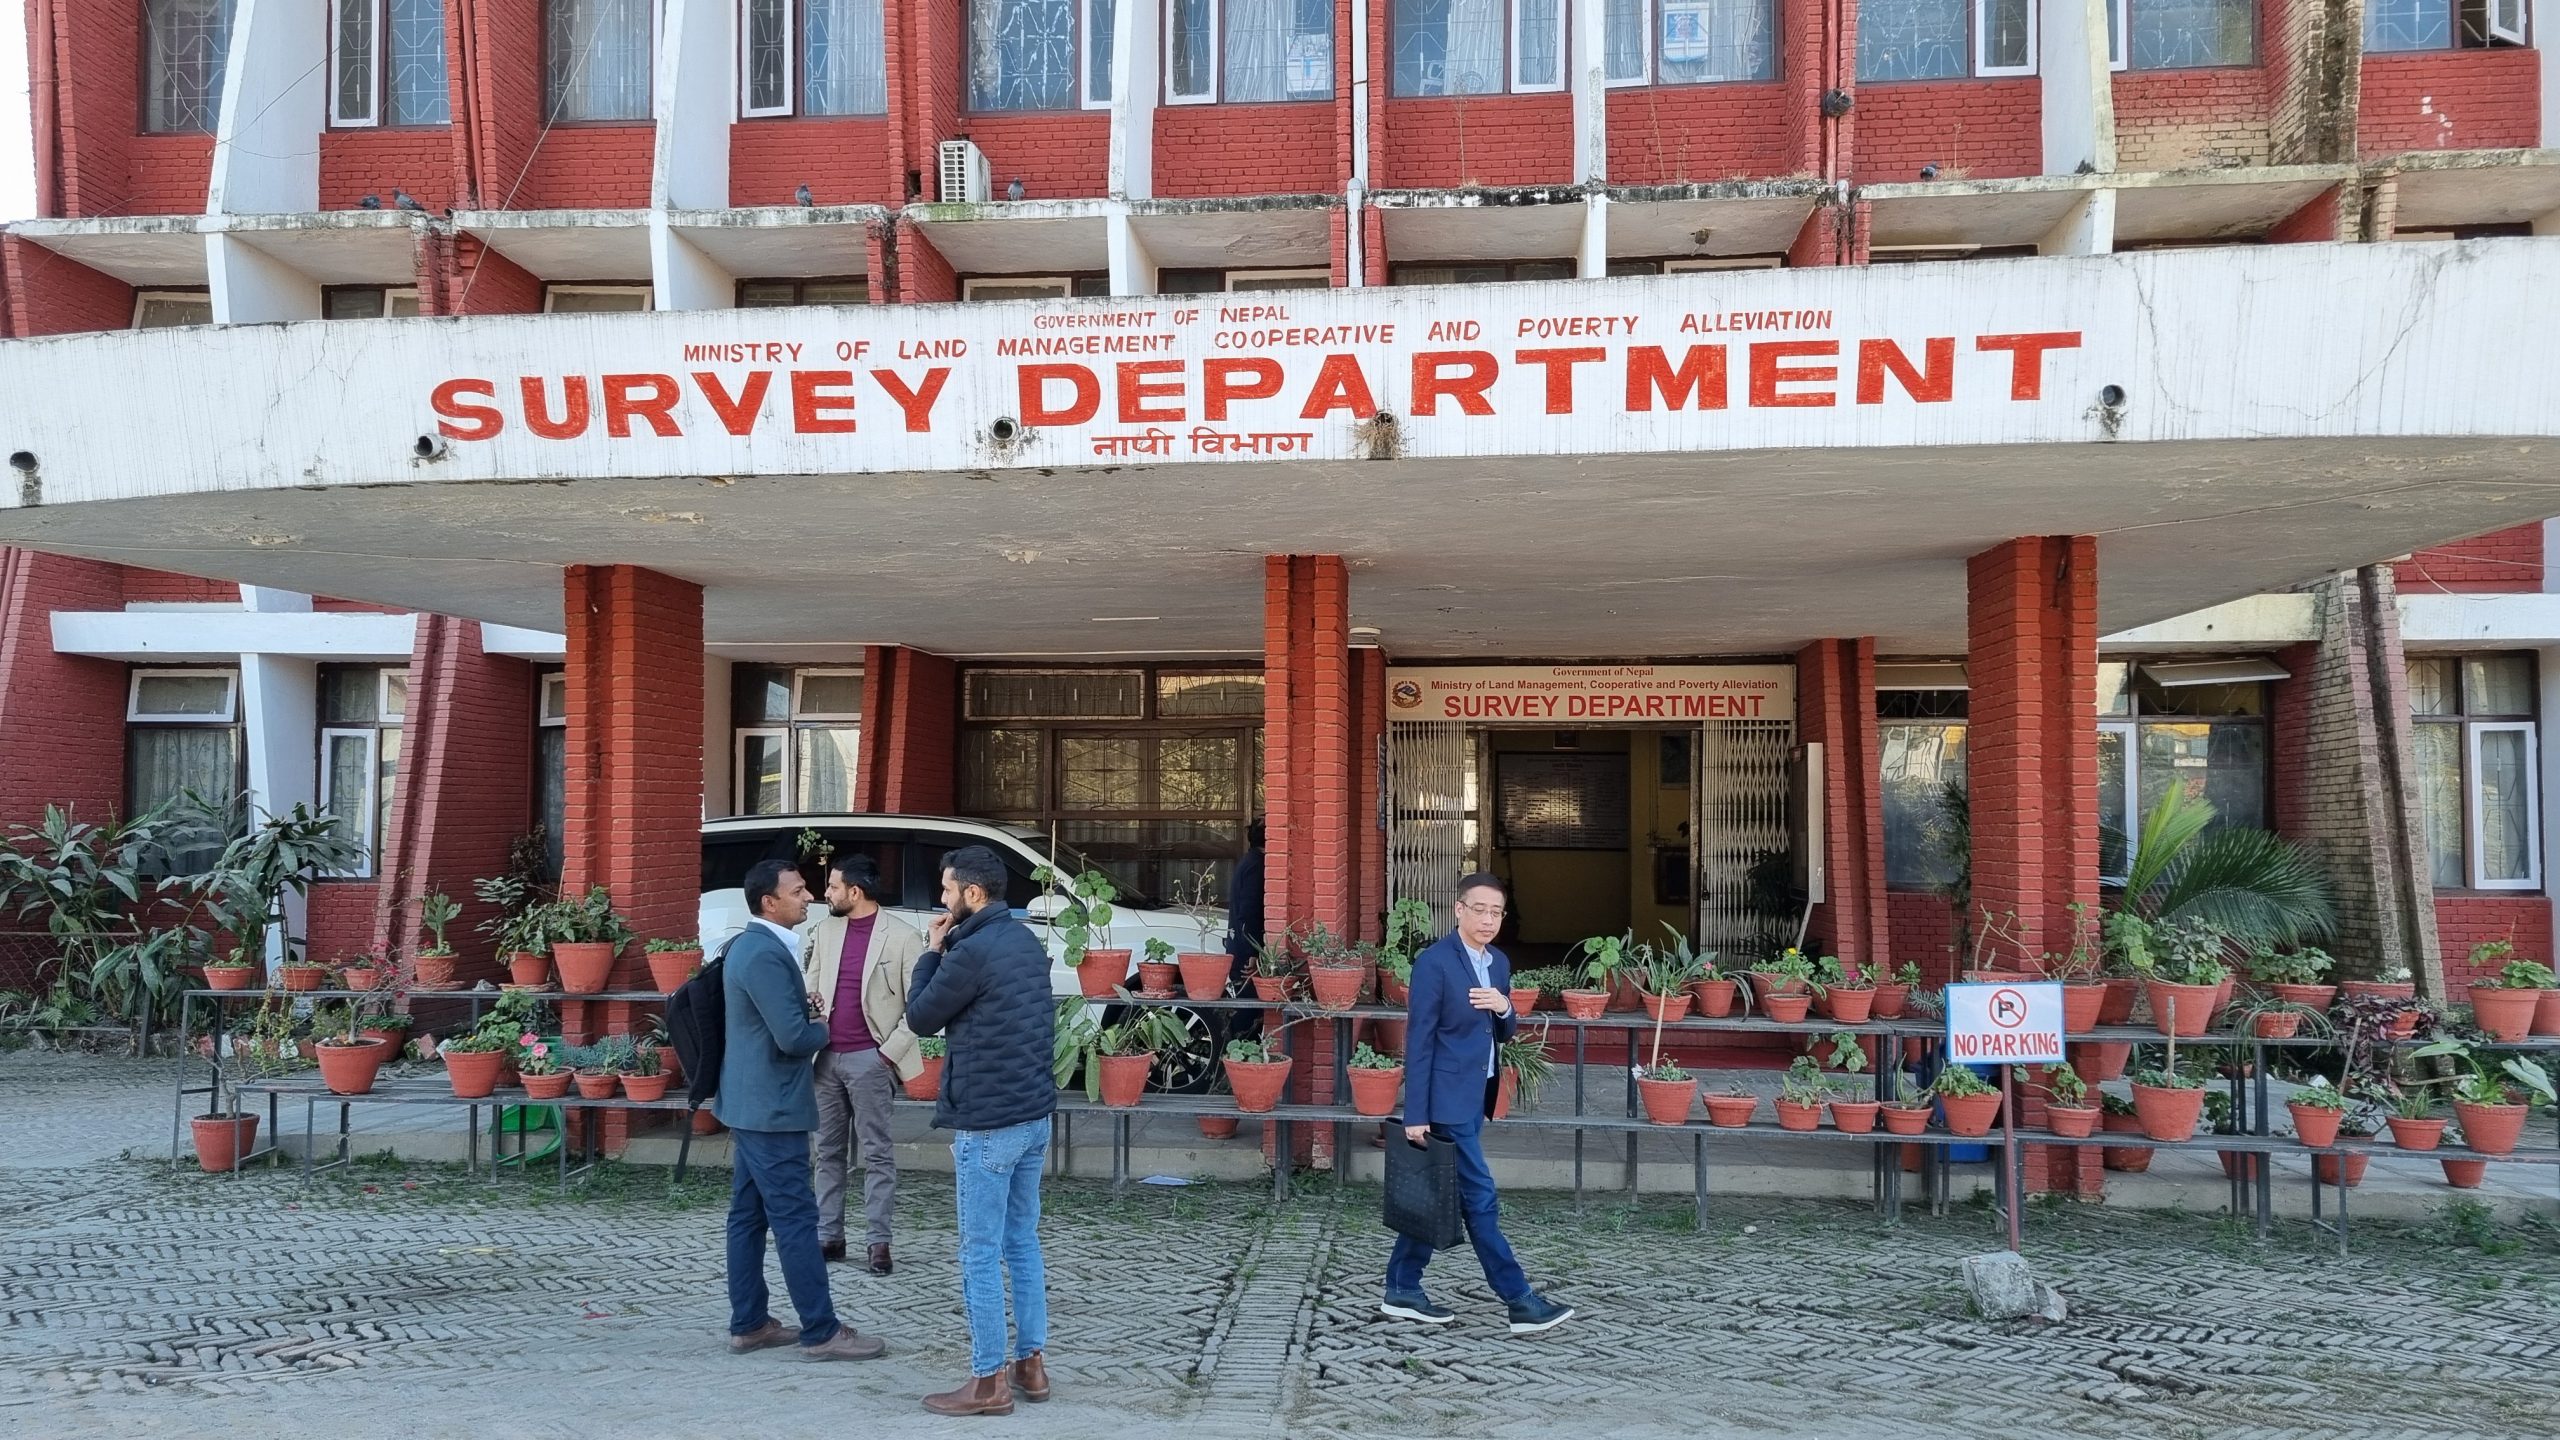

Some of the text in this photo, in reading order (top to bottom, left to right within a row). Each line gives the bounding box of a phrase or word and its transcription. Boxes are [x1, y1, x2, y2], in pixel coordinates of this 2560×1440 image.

[1034, 305, 1290, 330] GOVERNMENT OF NEPAL
[684, 309, 1833, 363] MINISTRY OF LAND MANAGEMENT COOPERATIVE AND POVERTY ALLEVIATION
[430, 330, 2083, 442] SURVEY DEPARTMENT
[1091, 426, 1313, 457] नापी विभाग
[1553, 667, 1654, 678] Government of Nepal
[1431, 679, 1778, 692] Ministry of Land Management, Cooperative and Poverty Alleviation
[1444, 695, 1765, 718] SURVEY DEPARTMENT
[1954, 1033, 2060, 1056] NO PARKING
